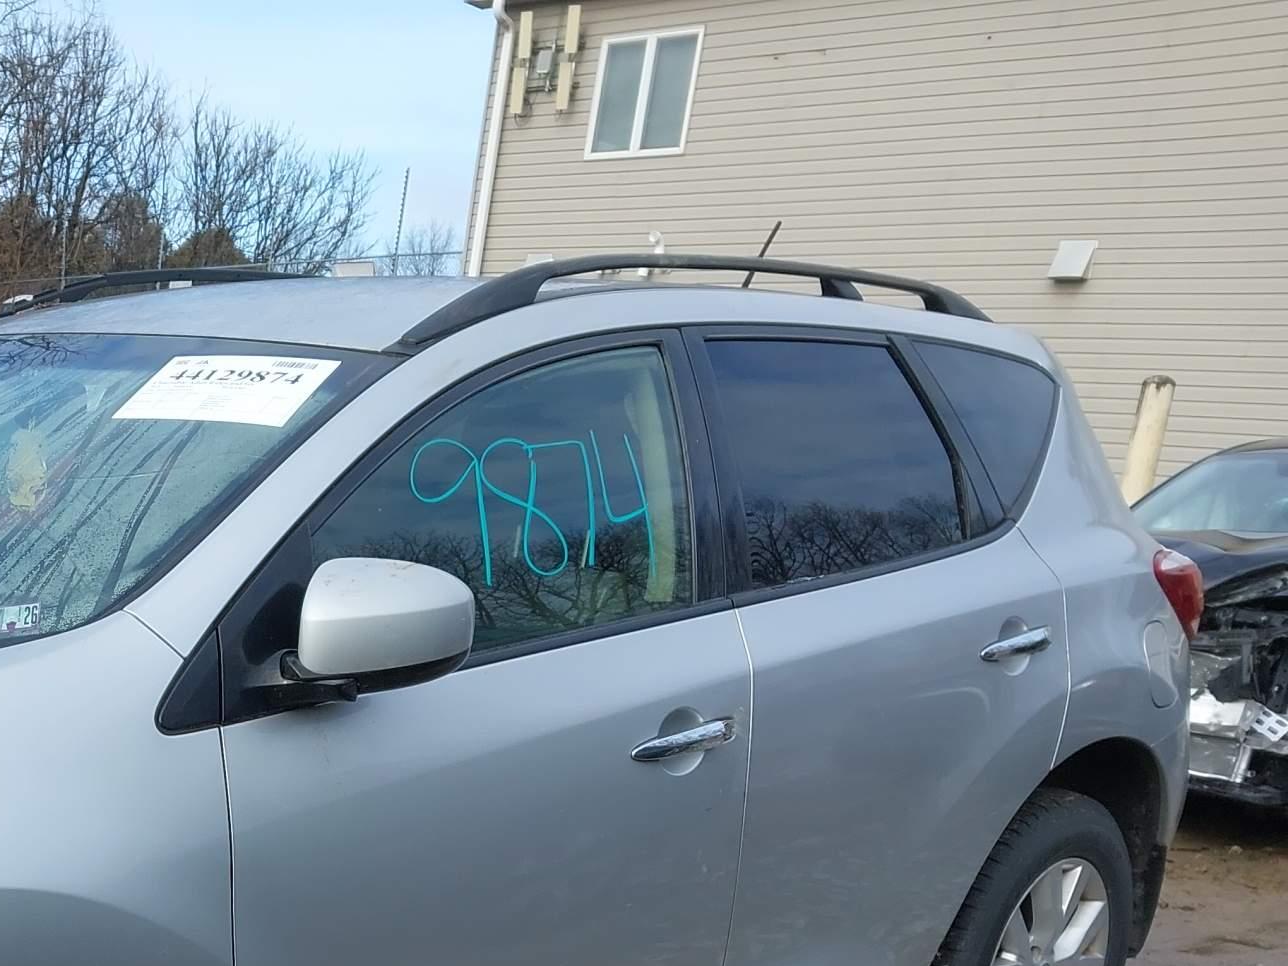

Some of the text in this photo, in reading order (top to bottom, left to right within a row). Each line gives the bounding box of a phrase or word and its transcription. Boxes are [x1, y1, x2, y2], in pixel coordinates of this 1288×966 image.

[169, 368, 305, 386] 44129874
[410, 429, 656, 587] 9874
[24, 605, 39, 625] 26
